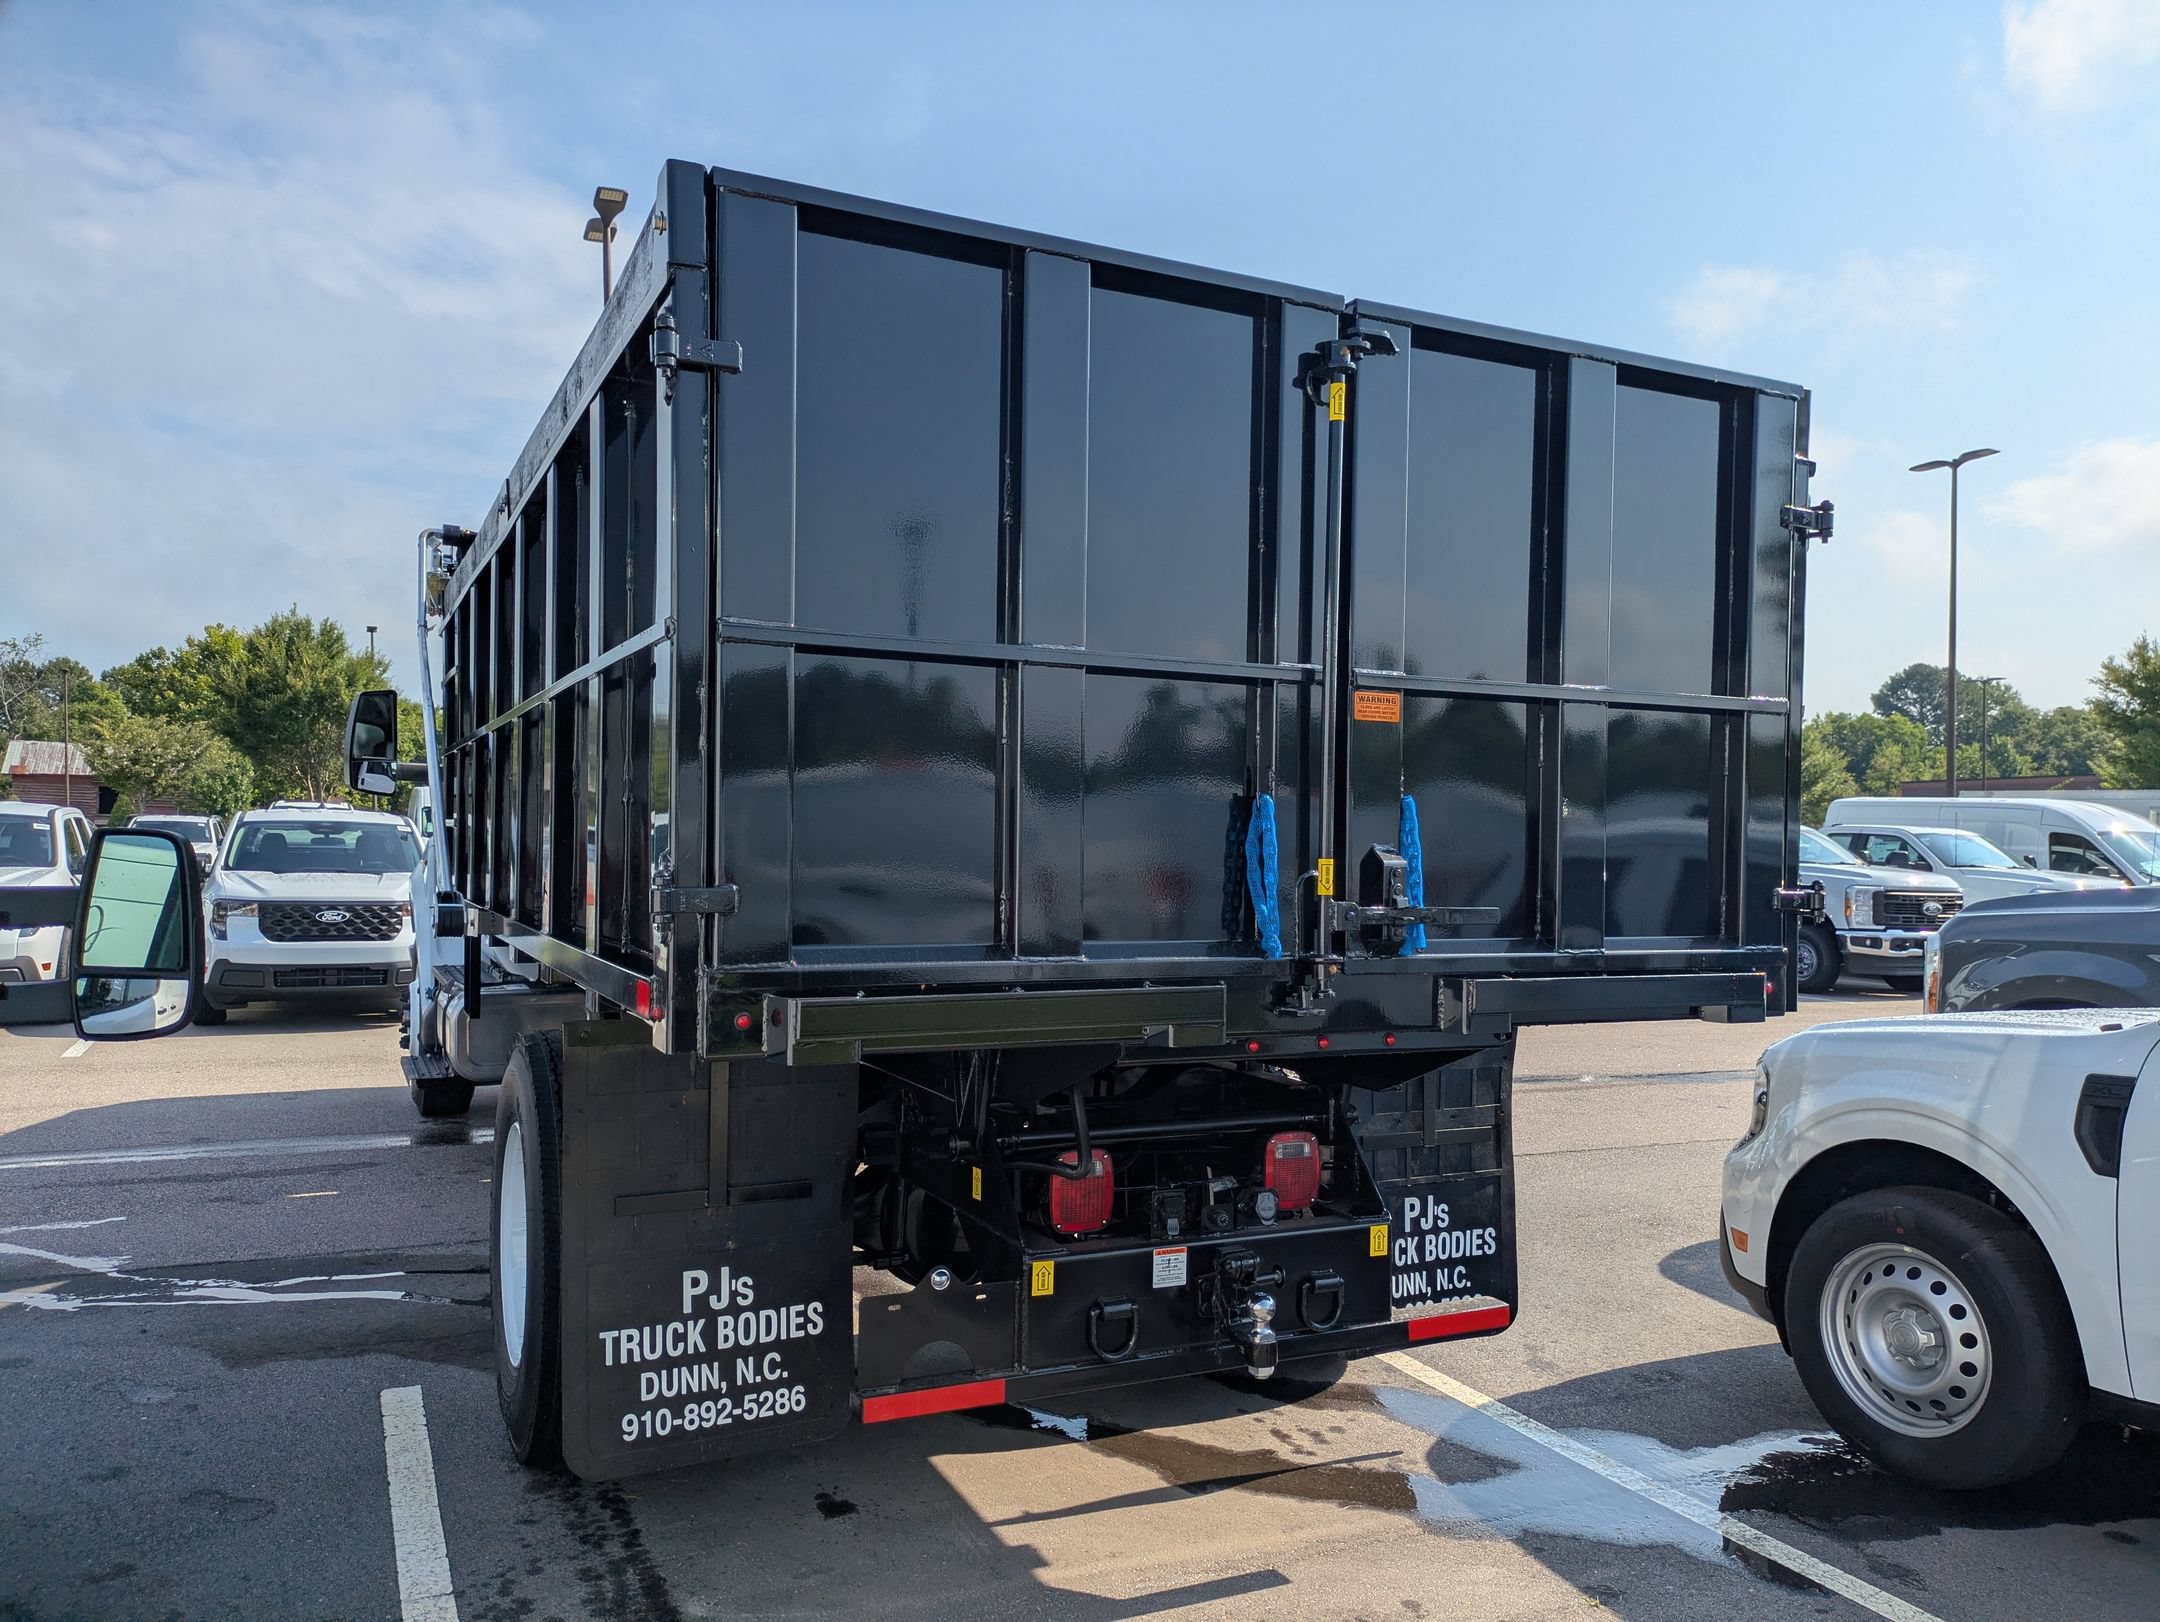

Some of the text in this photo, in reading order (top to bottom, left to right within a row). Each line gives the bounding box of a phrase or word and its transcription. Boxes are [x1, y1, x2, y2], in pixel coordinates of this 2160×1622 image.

[1358, 696, 1396, 704] WARNING
[1404, 1195, 1449, 1233] PJ's
[1425, 1227, 1496, 1262] BODIES
[683, 1266, 754, 1314] PJ's
[1391, 1265, 1471, 1298] UNN, N.C.
[599, 1302, 824, 1366] TRUCK BODIES
[641, 1352, 789, 1402] DUNN, N.C.
[621, 1386, 806, 1442] 910-892-5286
